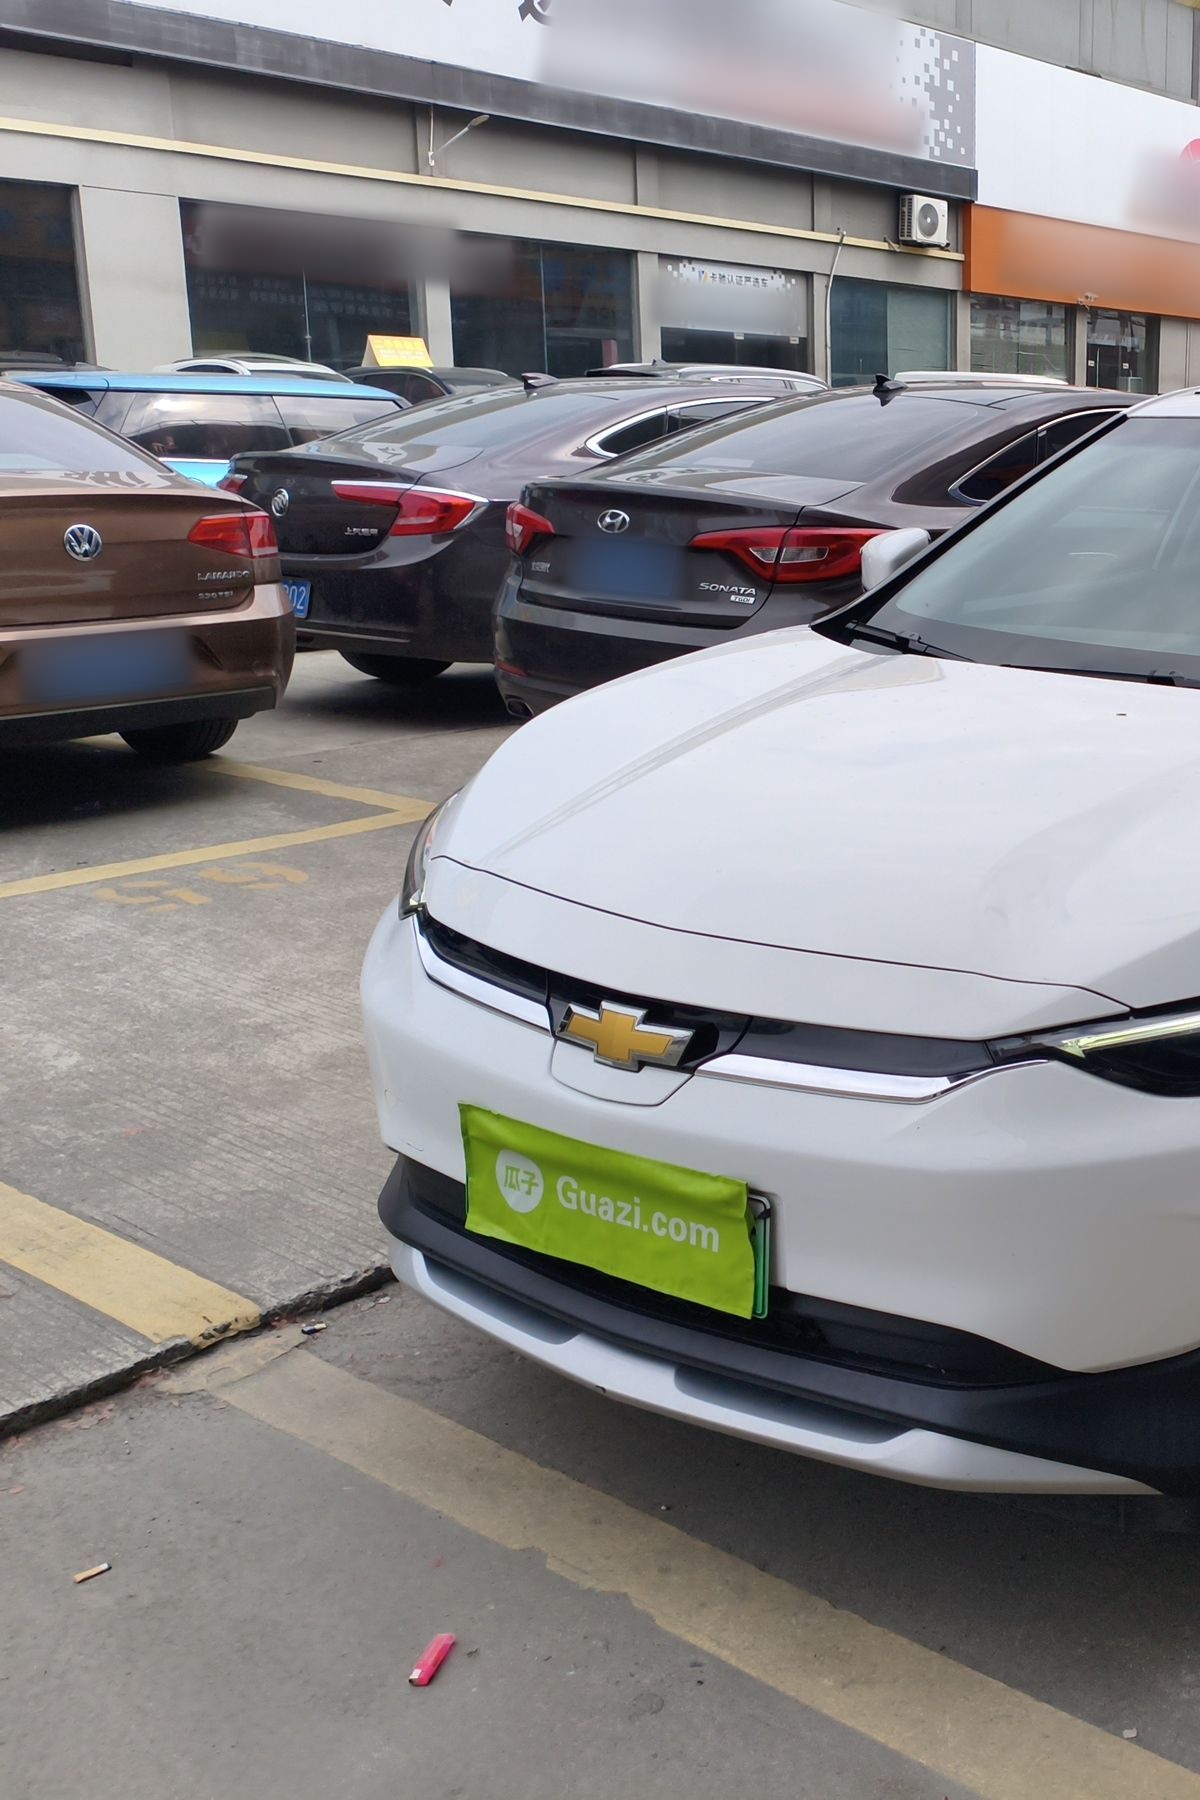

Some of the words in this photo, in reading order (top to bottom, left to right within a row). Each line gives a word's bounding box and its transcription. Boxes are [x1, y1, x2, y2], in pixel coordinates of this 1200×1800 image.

[698, 582, 756, 596] SONATA
[504, 1165, 539, 1196] 瓜子
[556, 1175, 720, 1253] Guazi.com
